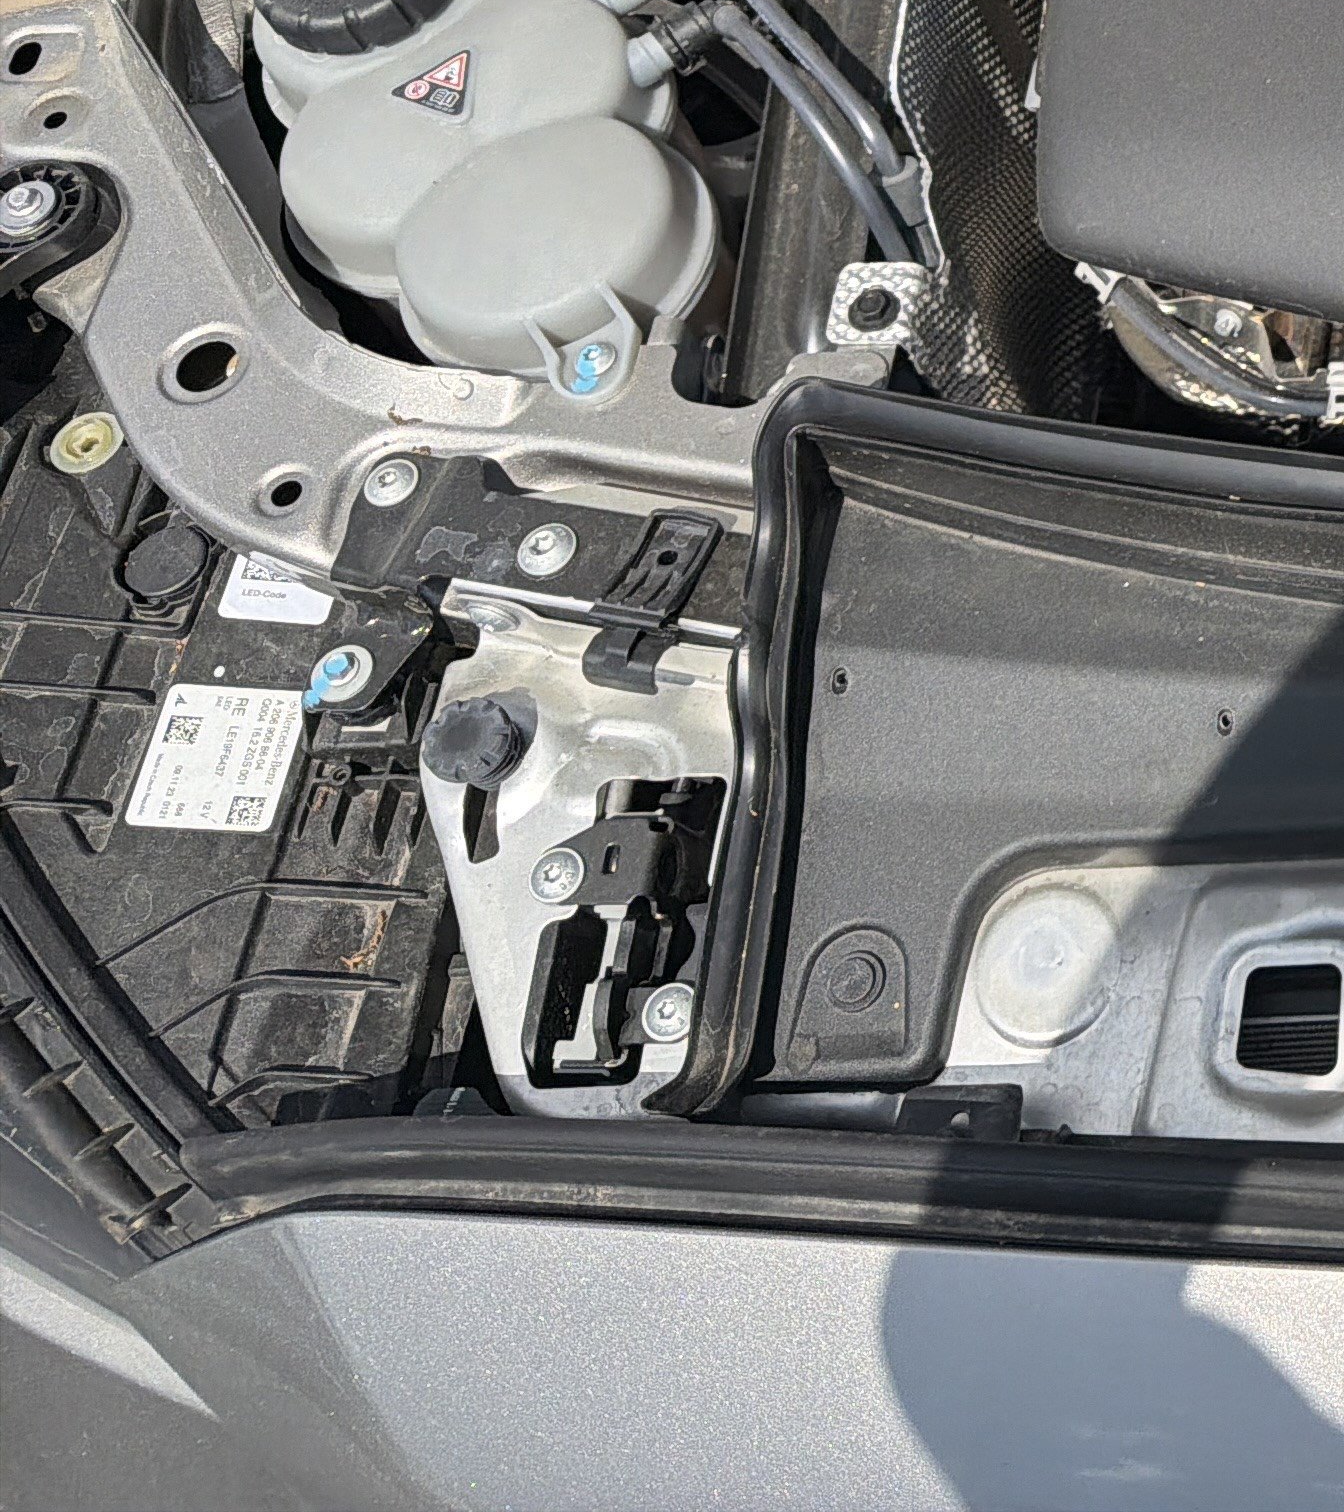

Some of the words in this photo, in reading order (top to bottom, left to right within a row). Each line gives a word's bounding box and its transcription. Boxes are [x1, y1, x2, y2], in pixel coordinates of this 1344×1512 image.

[242, 588, 287, 599] LED-Code
[231, 697, 250, 717] RE
[268, 708, 281, 725] 206
[264, 709, 298, 786] Mercedes-Benz
[242, 746, 257, 769] ZGS
[236, 768, 250, 786] 001
[202, 800, 213, 811] 12
